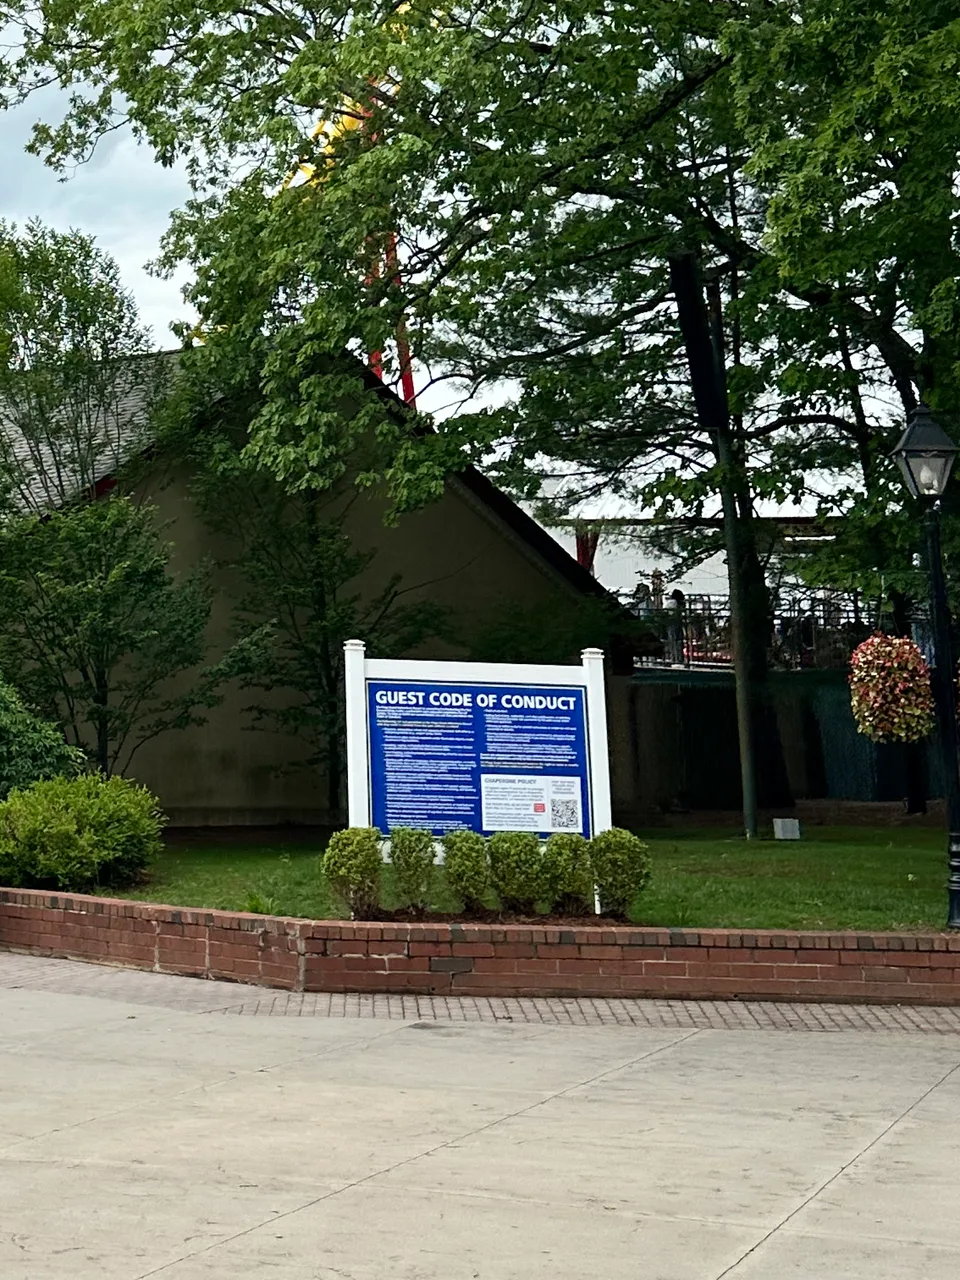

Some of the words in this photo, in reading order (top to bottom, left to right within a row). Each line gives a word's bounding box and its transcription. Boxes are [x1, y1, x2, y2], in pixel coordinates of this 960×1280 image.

[375, 690, 425, 705] GUEST
[429, 692, 473, 707] CODE
[476, 693, 497, 708] OF
[501, 694, 576, 710] CONDUCT
